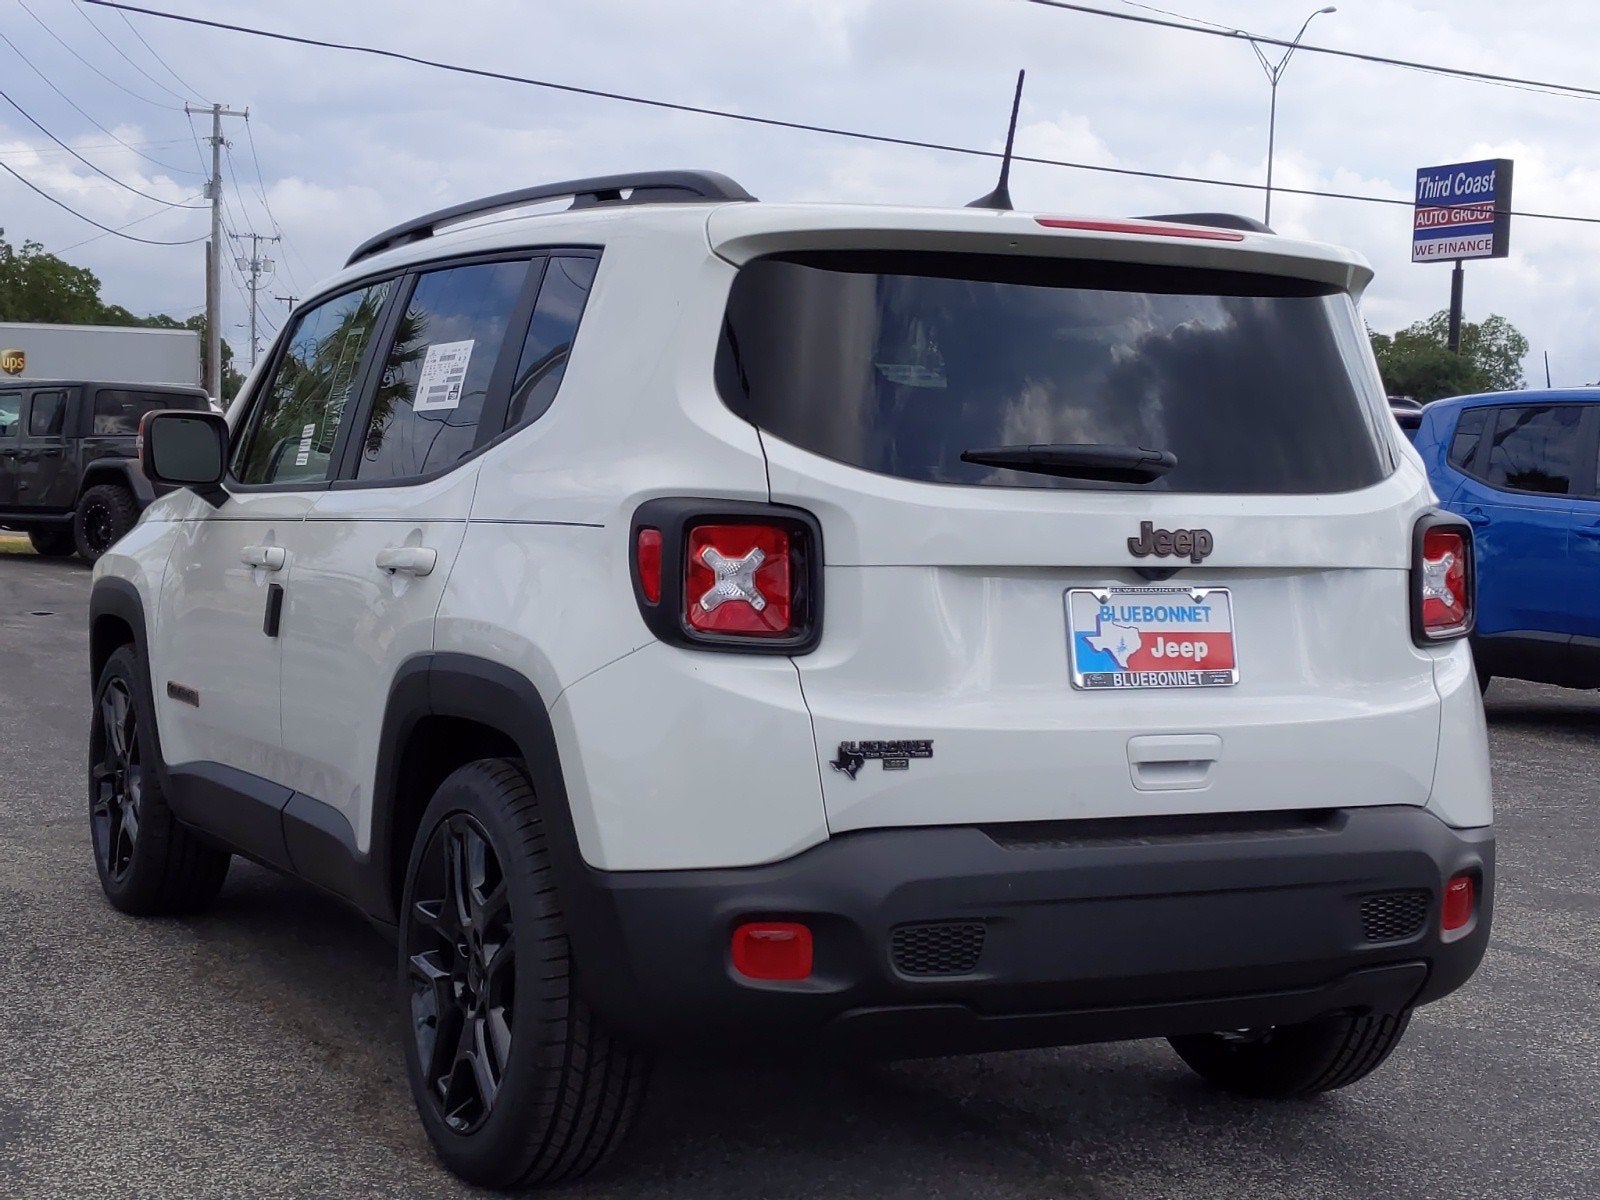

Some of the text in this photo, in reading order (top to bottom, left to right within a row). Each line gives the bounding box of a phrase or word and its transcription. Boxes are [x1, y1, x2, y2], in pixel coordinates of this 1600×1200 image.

[1418, 170, 1496, 200] Third Coast
[1416, 205, 1494, 226] AUTO GROUP
[1415, 239, 1491, 256] WE FINANCE
[1127, 521, 1214, 564] Jeep
[1100, 606, 1212, 623] BLUEBONNET
[1151, 637, 1209, 662] Jeep
[1113, 673, 1204, 687] BLUEBONNET
